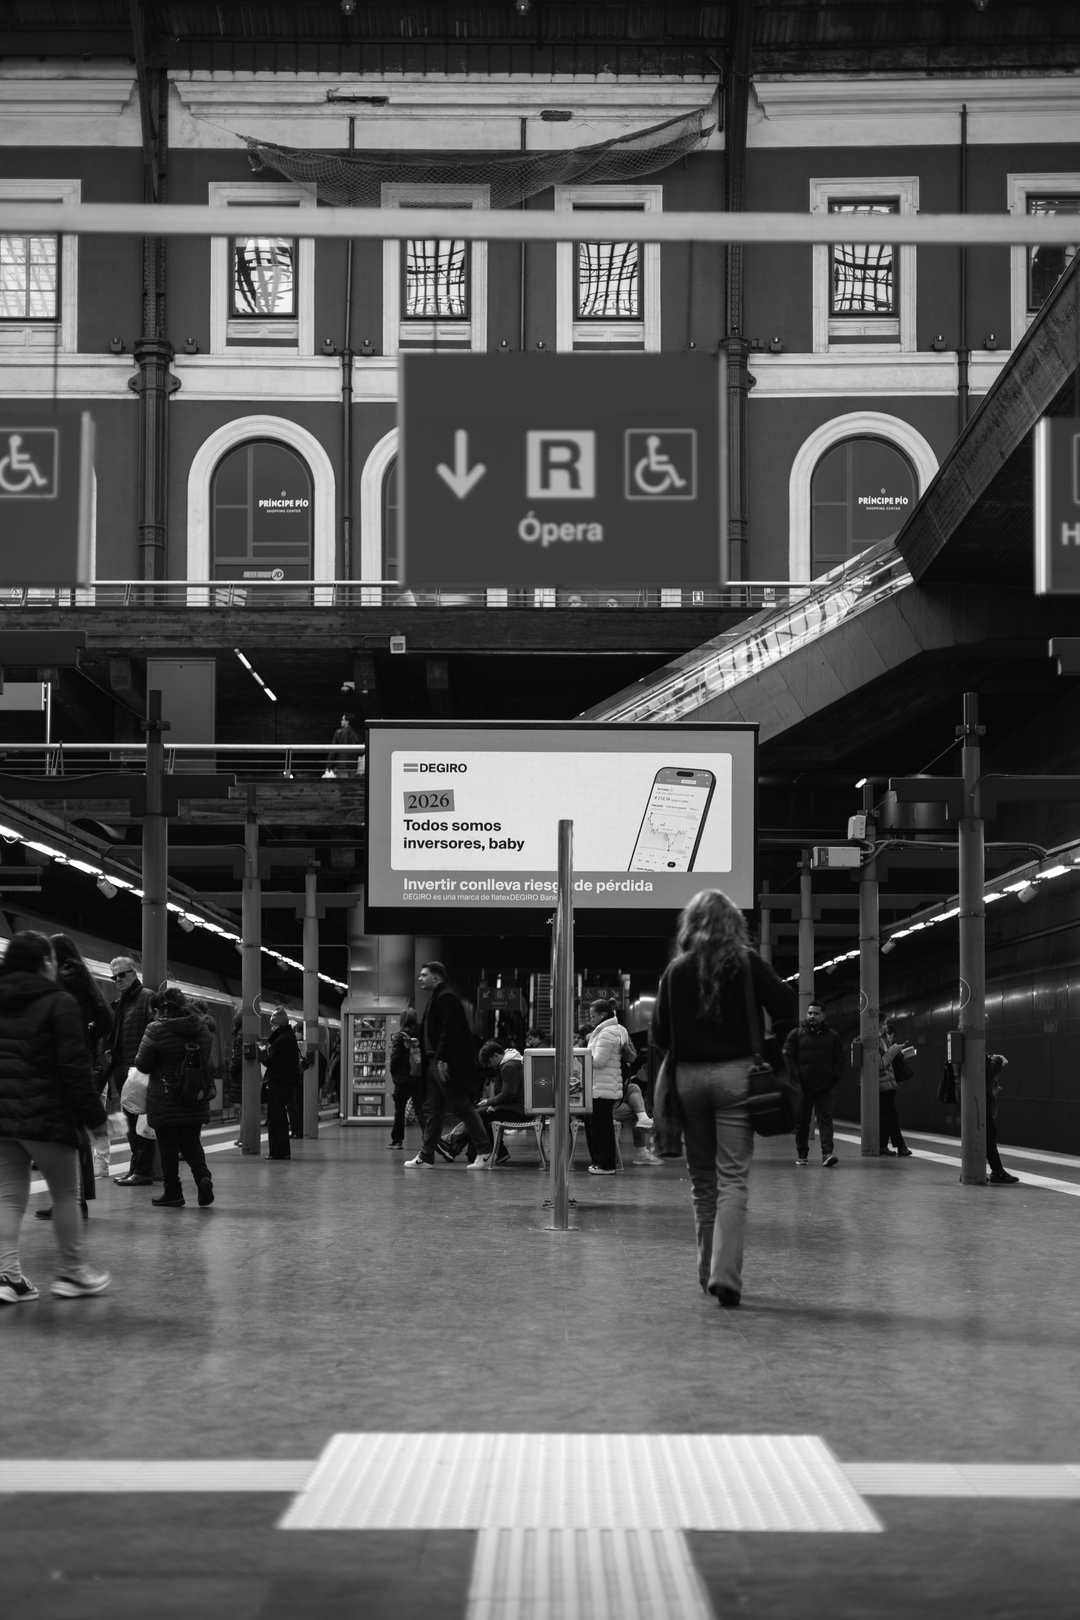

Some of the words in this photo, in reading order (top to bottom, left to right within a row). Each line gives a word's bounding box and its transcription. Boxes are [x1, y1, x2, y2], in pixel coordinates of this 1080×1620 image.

[258, 498, 294, 508] PRÍNCIPE
[296, 498, 309, 508] PÍO
[858, 496, 893, 505] PRÍNCIPE
[895, 496, 908, 505] PÍO
[517, 511, 603, 547] Ópera
[419, 763, 468, 773] DEGIRO
[407, 792, 450, 809] 2026
[403, 819, 448, 831] Todos
[451, 821, 502, 832] somos
[403, 837, 486, 851] inversores,
[489, 838, 525, 852] baby
[403, 878, 456, 891] Invertir
[459, 878, 521, 891] conlleva
[524, 879, 560, 894] riesg
[574, 879, 593, 891] de
[596, 879, 654, 893] pérdida
[403, 893, 431, 901] DEGIRO
[491, 893, 539, 902] flatexDEGIRO
[496, 990, 503, 999] 6
[598, 990, 607, 998] 10
